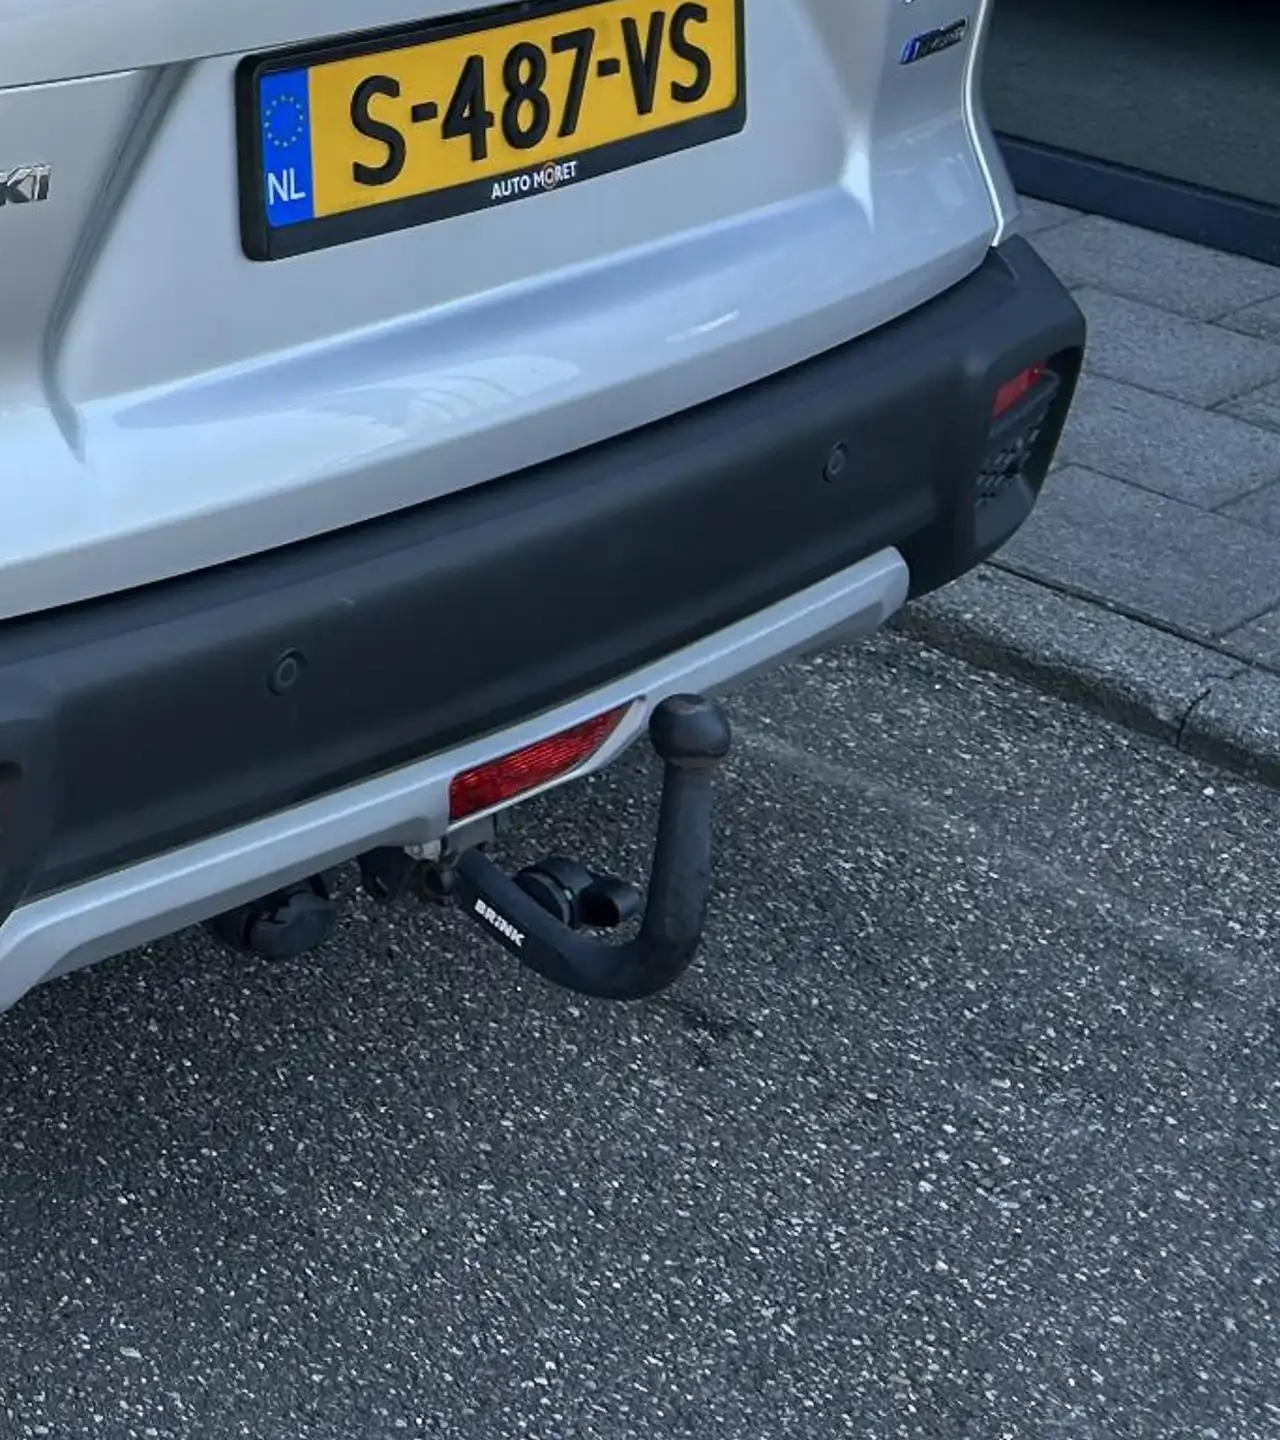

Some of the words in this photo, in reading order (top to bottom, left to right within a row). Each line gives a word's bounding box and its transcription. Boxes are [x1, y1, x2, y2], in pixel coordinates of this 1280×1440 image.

[350, 2, 711, 186] S-487-VS
[266, 168, 306, 205] NL
[491, 174, 531, 200] AUTO
[533, 161, 578, 191] MORET
[474, 898, 526, 947] BRINK
